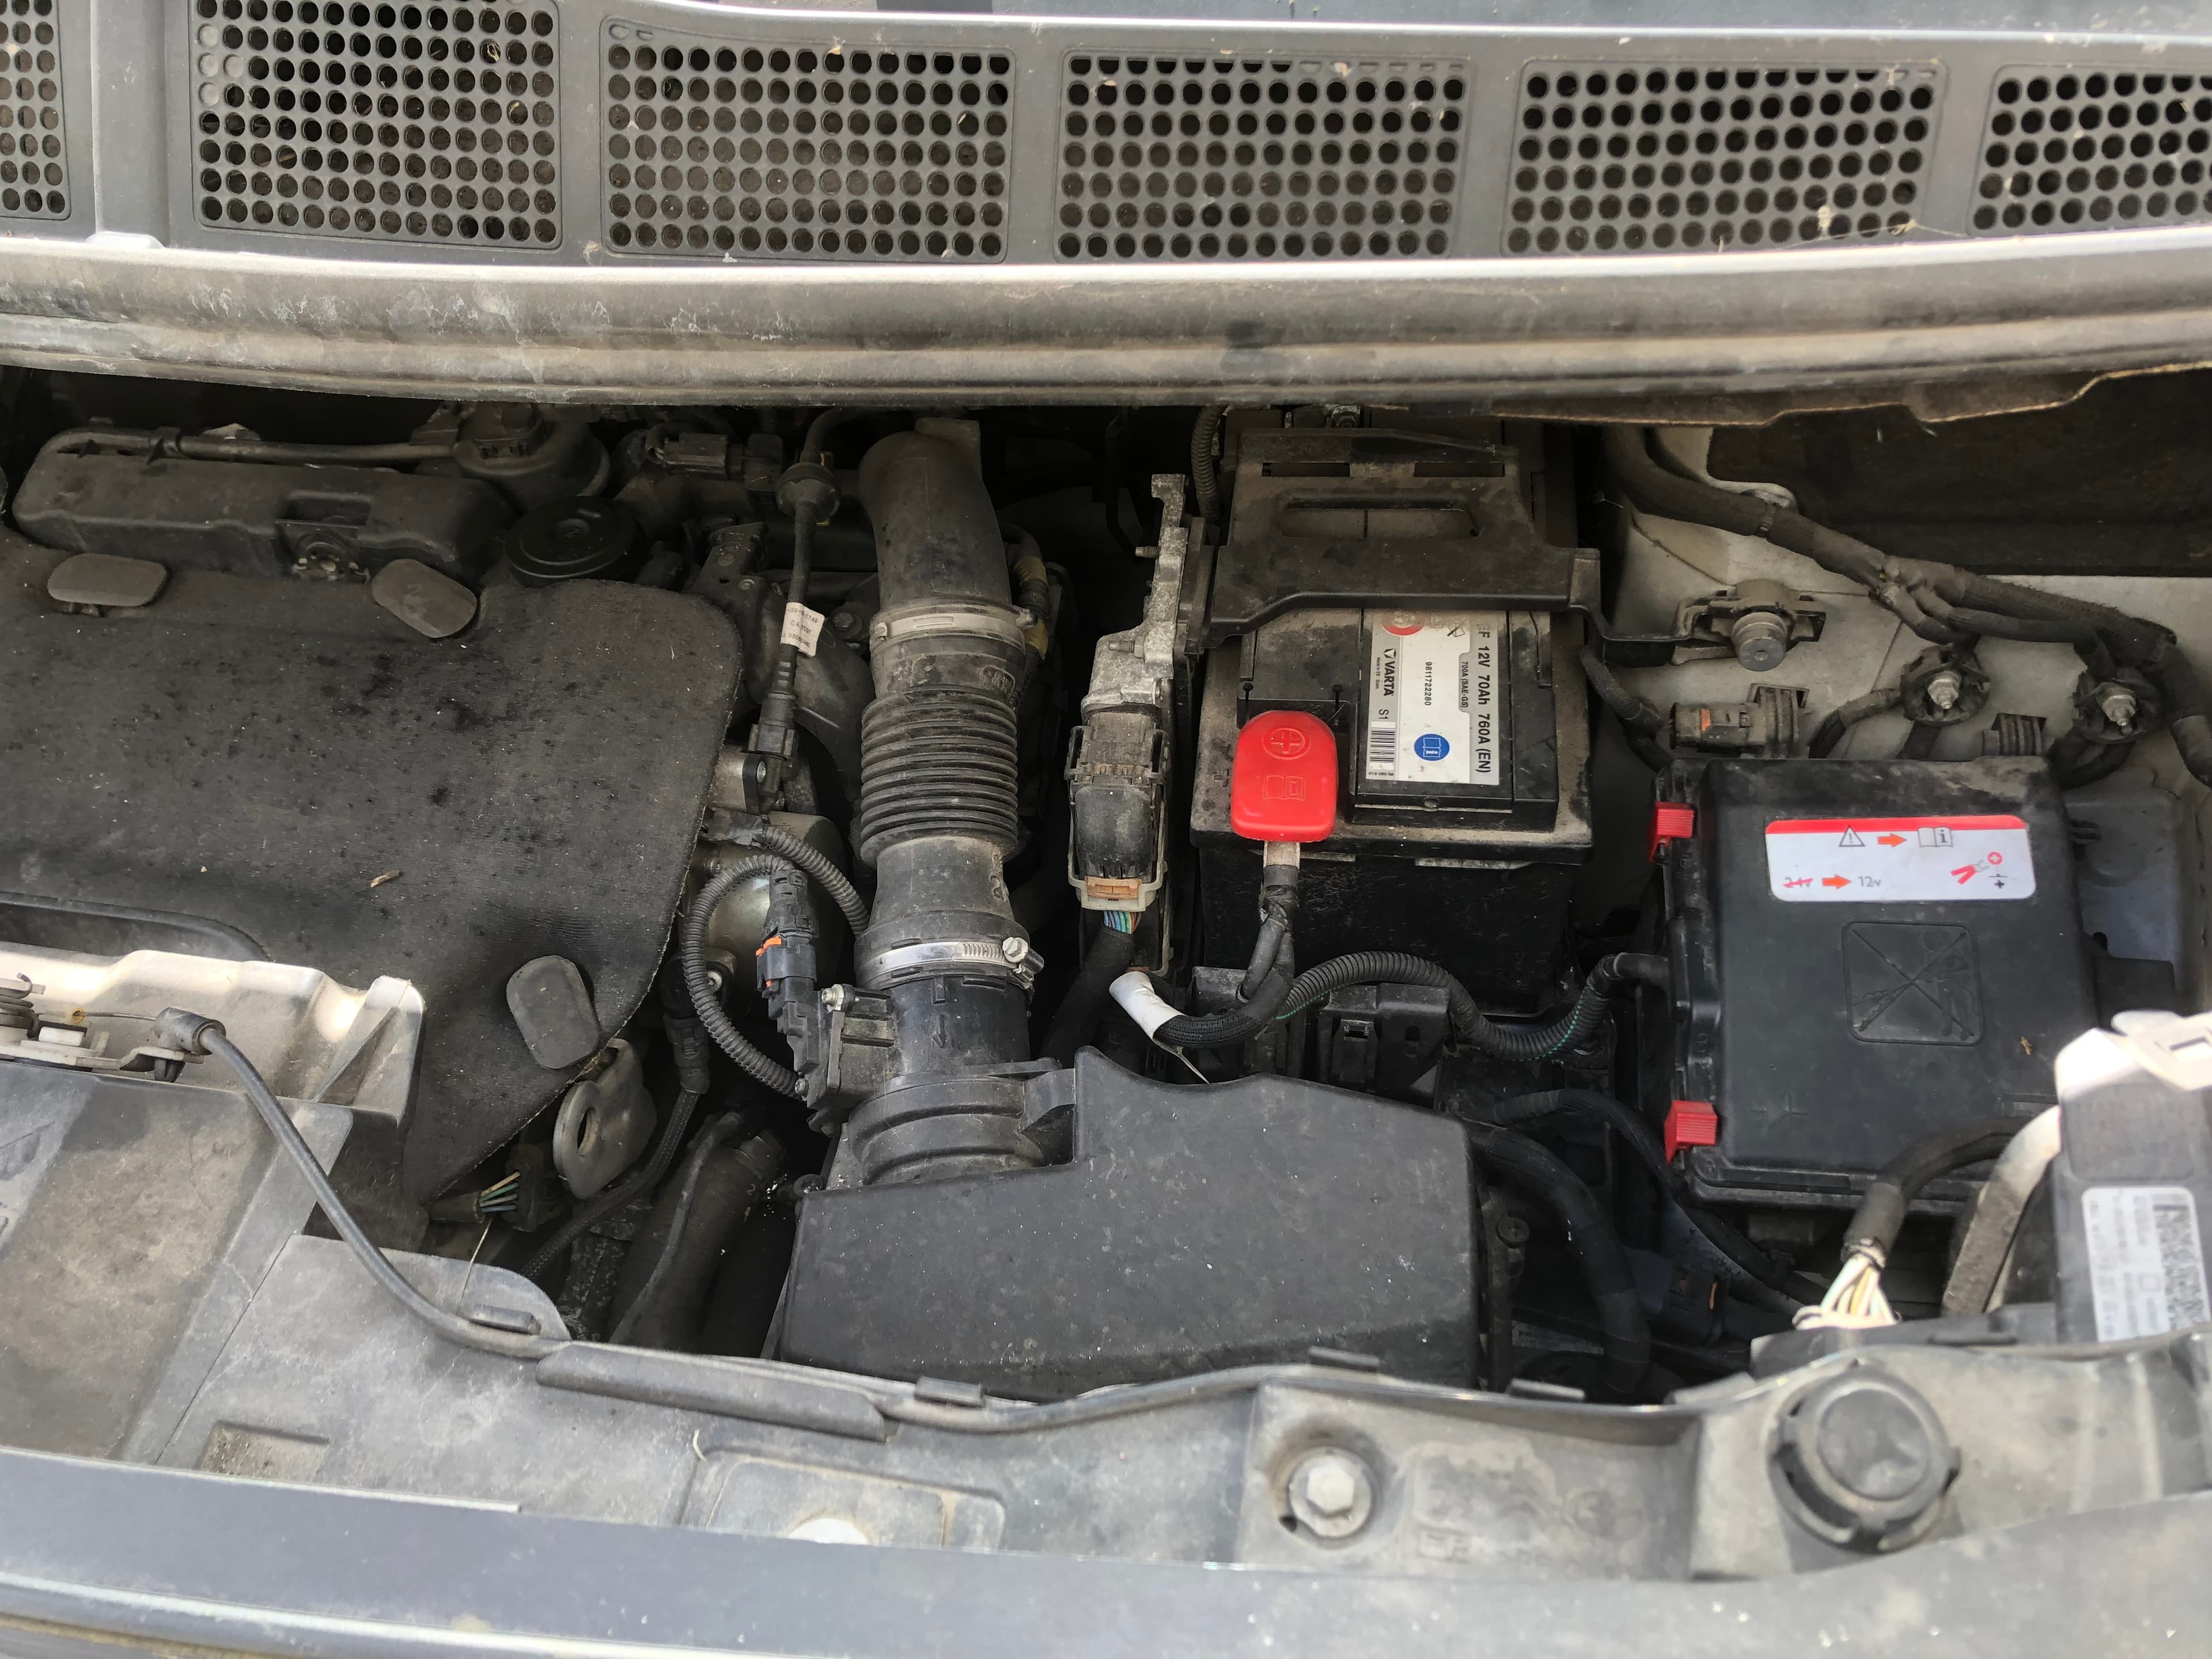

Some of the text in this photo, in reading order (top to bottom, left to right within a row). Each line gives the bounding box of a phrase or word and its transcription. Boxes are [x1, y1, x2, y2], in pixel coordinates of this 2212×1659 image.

[1478, 646, 1490, 667] 12V
[1384, 661, 1395, 696] VARTA
[1478, 675, 1490, 705] 70Ah
[1378, 709, 1389, 719] S1
[1478, 714, 1491, 744] 760A
[1475, 748, 1491, 773] (EN)
[1858, 876, 1881, 887] 12v
